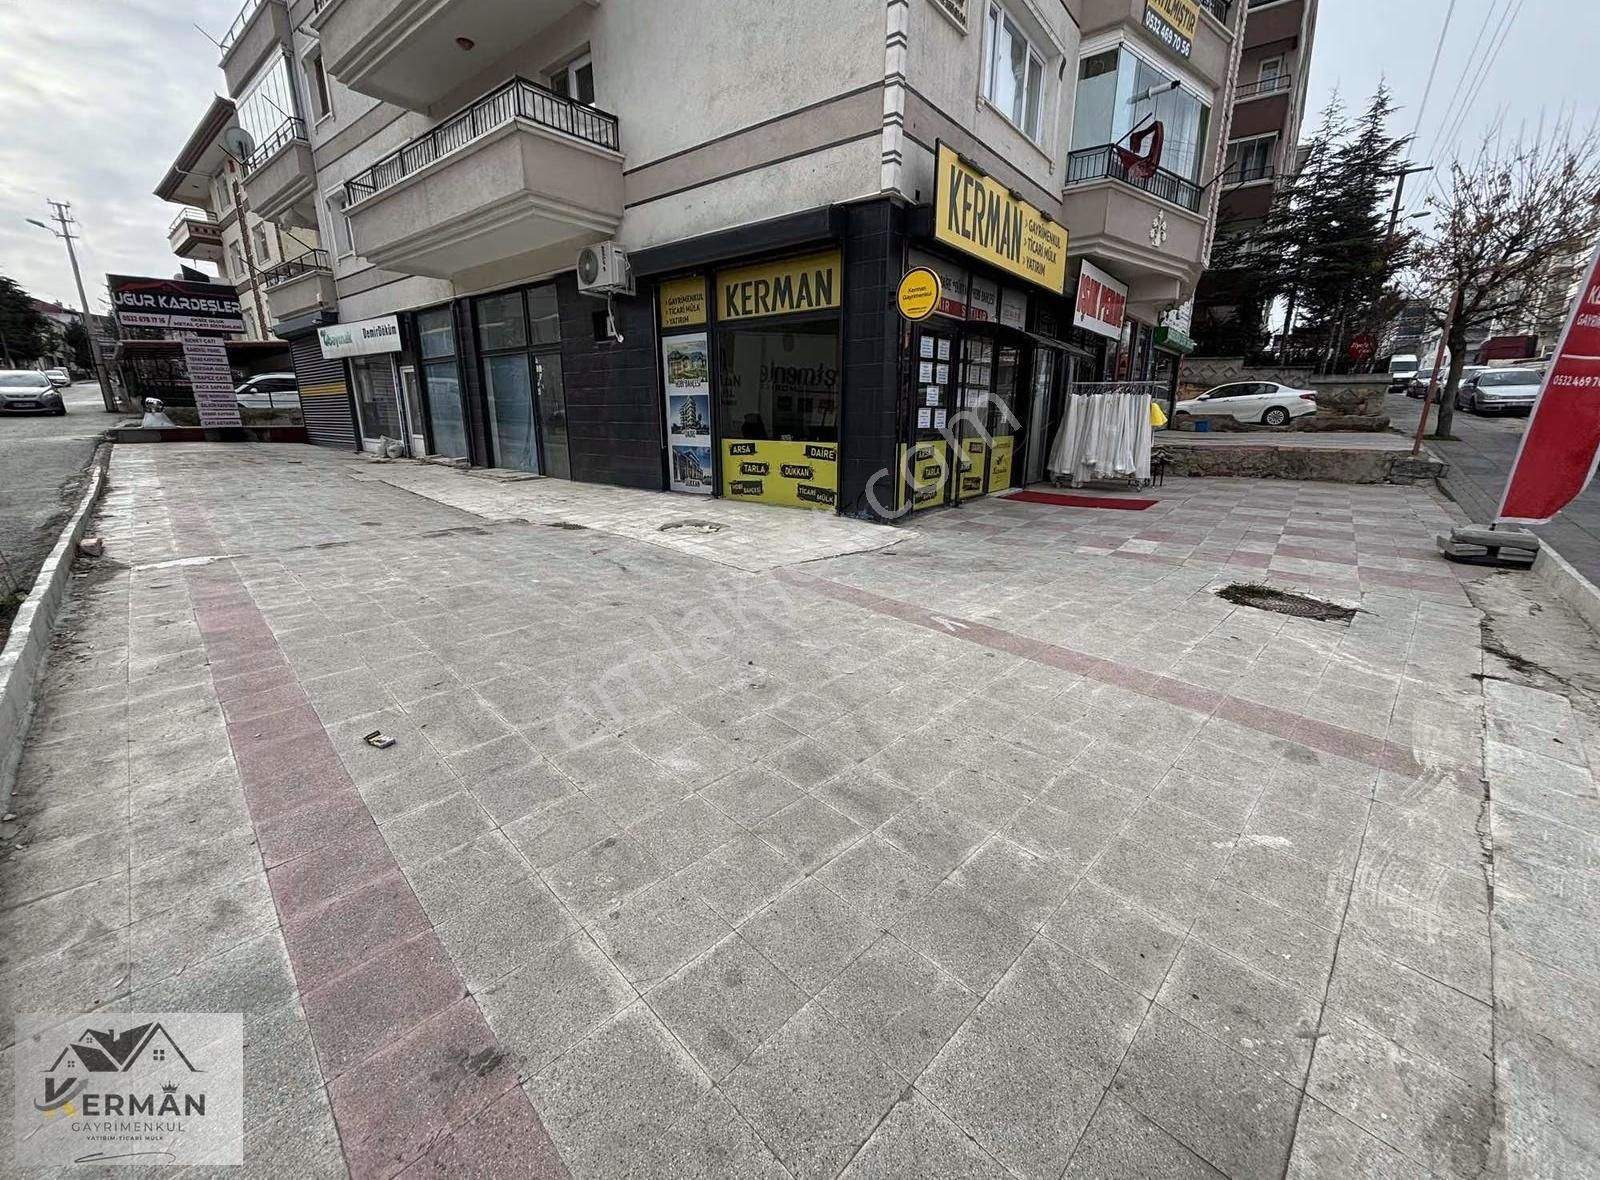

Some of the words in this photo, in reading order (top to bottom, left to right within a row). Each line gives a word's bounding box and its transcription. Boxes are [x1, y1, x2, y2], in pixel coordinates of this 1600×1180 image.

[1146, 11, 1161, 35] 0532
[1161, 25, 1173, 44] 469
[1172, 34, 1181, 51] 70
[1181, 40, 1190, 56] 56
[948, 164, 1023, 264] KERMAN
[726, 268, 832, 318] KERMAN
[112, 290, 156, 307] UĞUR
[158, 295, 242, 315] KARDEŞLER
[1553, 374, 1572, 386] 0532
[1572, 376, 1591, 387] 469
[733, 445, 751, 454] ARSA
[810, 447, 835, 459] DAİRE
[744, 464, 766, 473] TARLA
[785, 466, 810, 476] DÜKKAN
